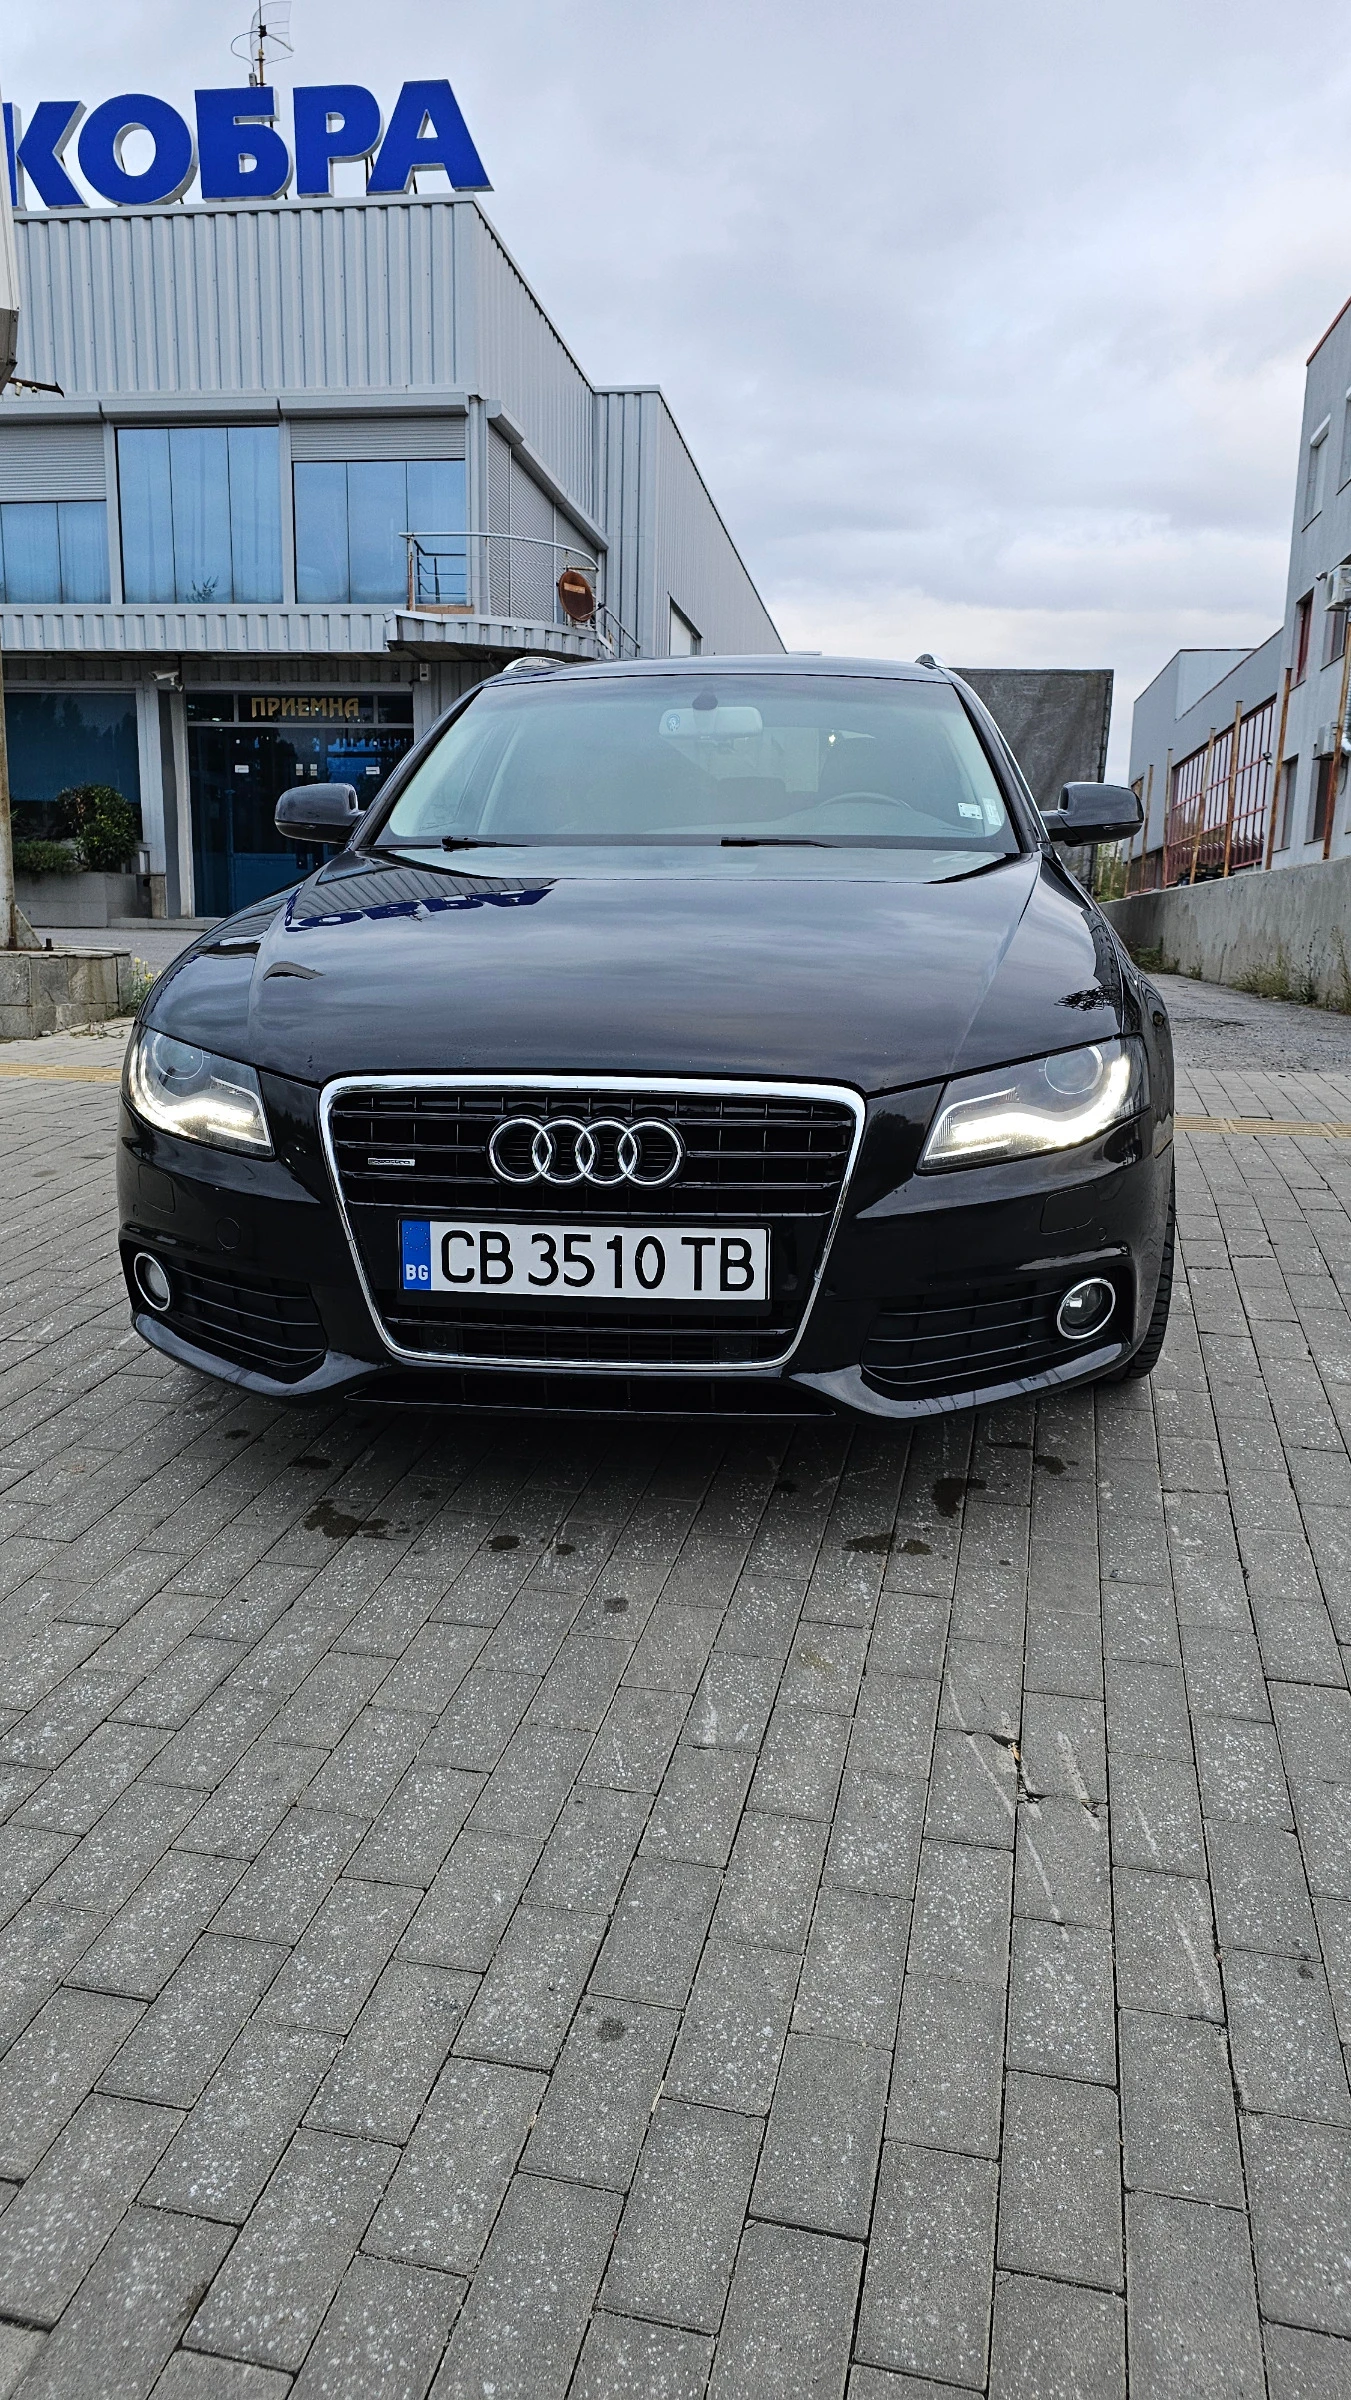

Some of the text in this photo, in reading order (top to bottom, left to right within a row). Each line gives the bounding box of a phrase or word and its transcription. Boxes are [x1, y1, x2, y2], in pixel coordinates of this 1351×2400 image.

[3, 79, 493, 211] КОБРА
[251, 697, 360, 719] ПРИЕМНА
[405, 1263, 429, 1281] BG
[441, 1230, 755, 1292] CB 3510 TB
